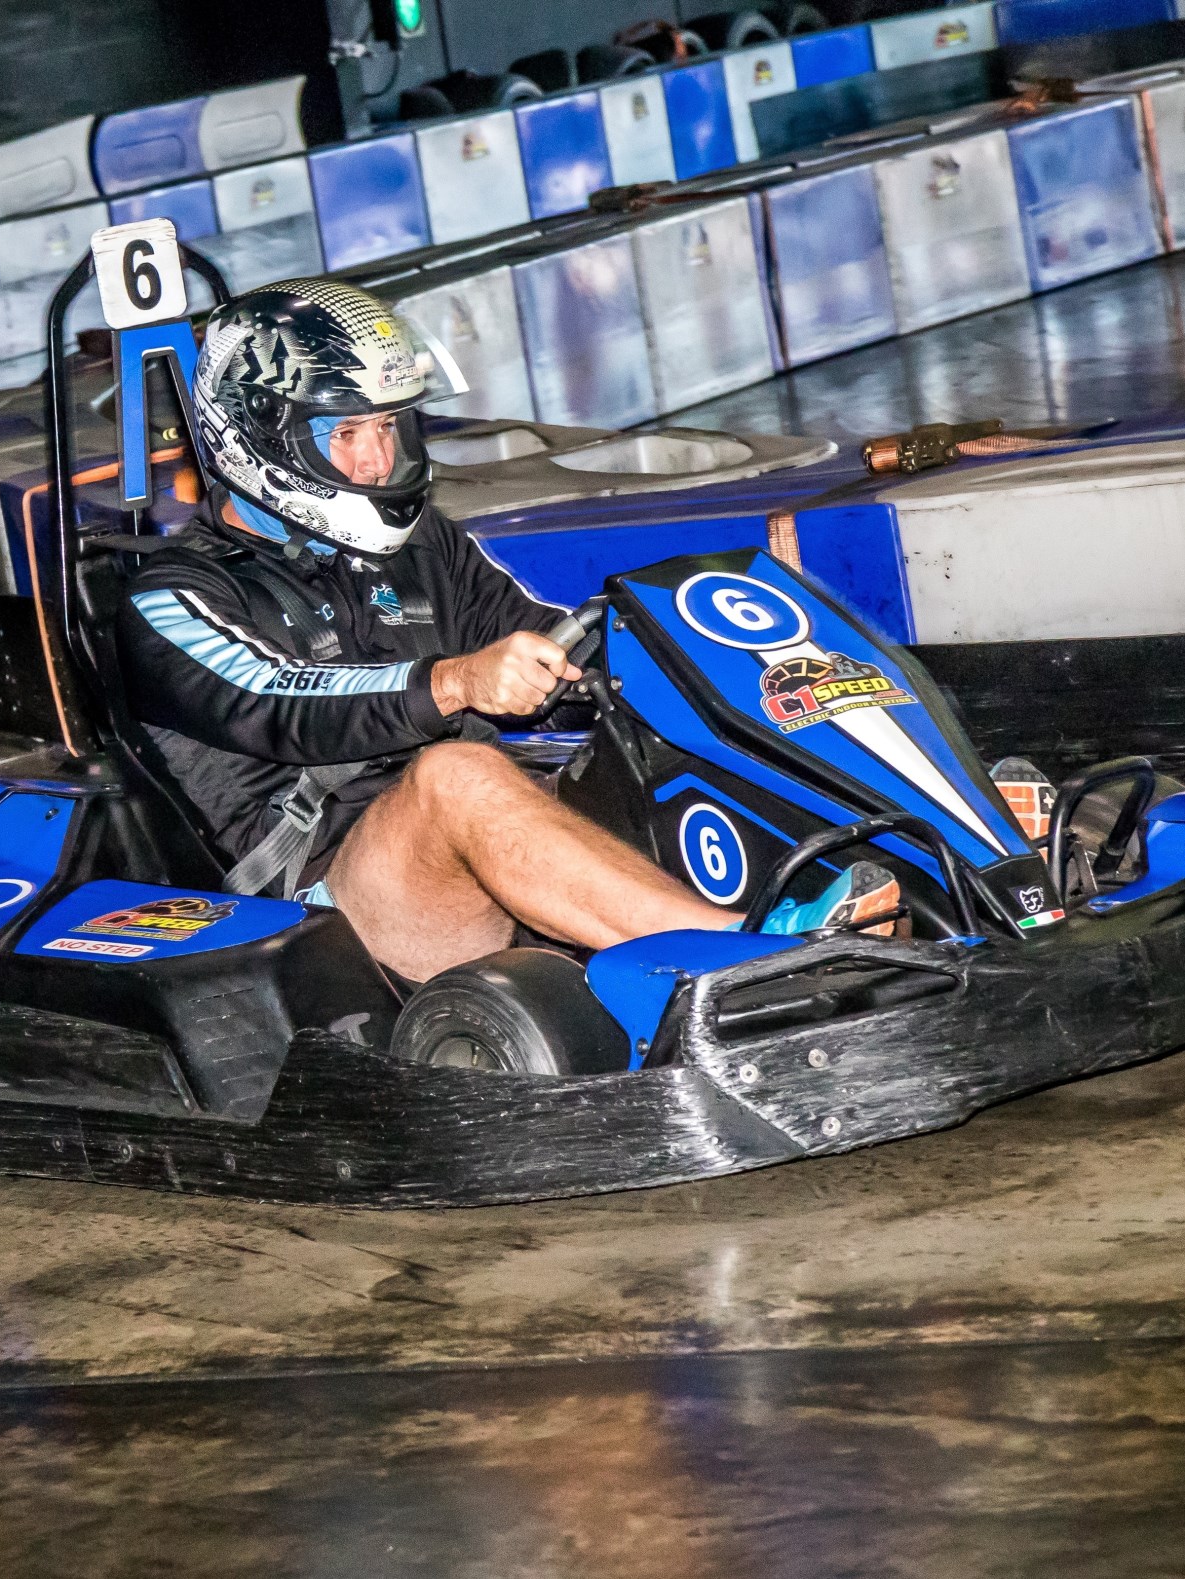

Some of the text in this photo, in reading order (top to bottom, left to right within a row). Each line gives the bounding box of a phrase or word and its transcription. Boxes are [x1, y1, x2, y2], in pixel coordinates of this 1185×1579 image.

[122, 238, 162, 311] 6
[711, 588, 775, 631] 6
[785, 711, 831, 732] ELECTRIC
[833, 701, 871, 715] INDOOR
[699, 826, 728, 881] 6
[52, 939, 147, 956] NO STEP
